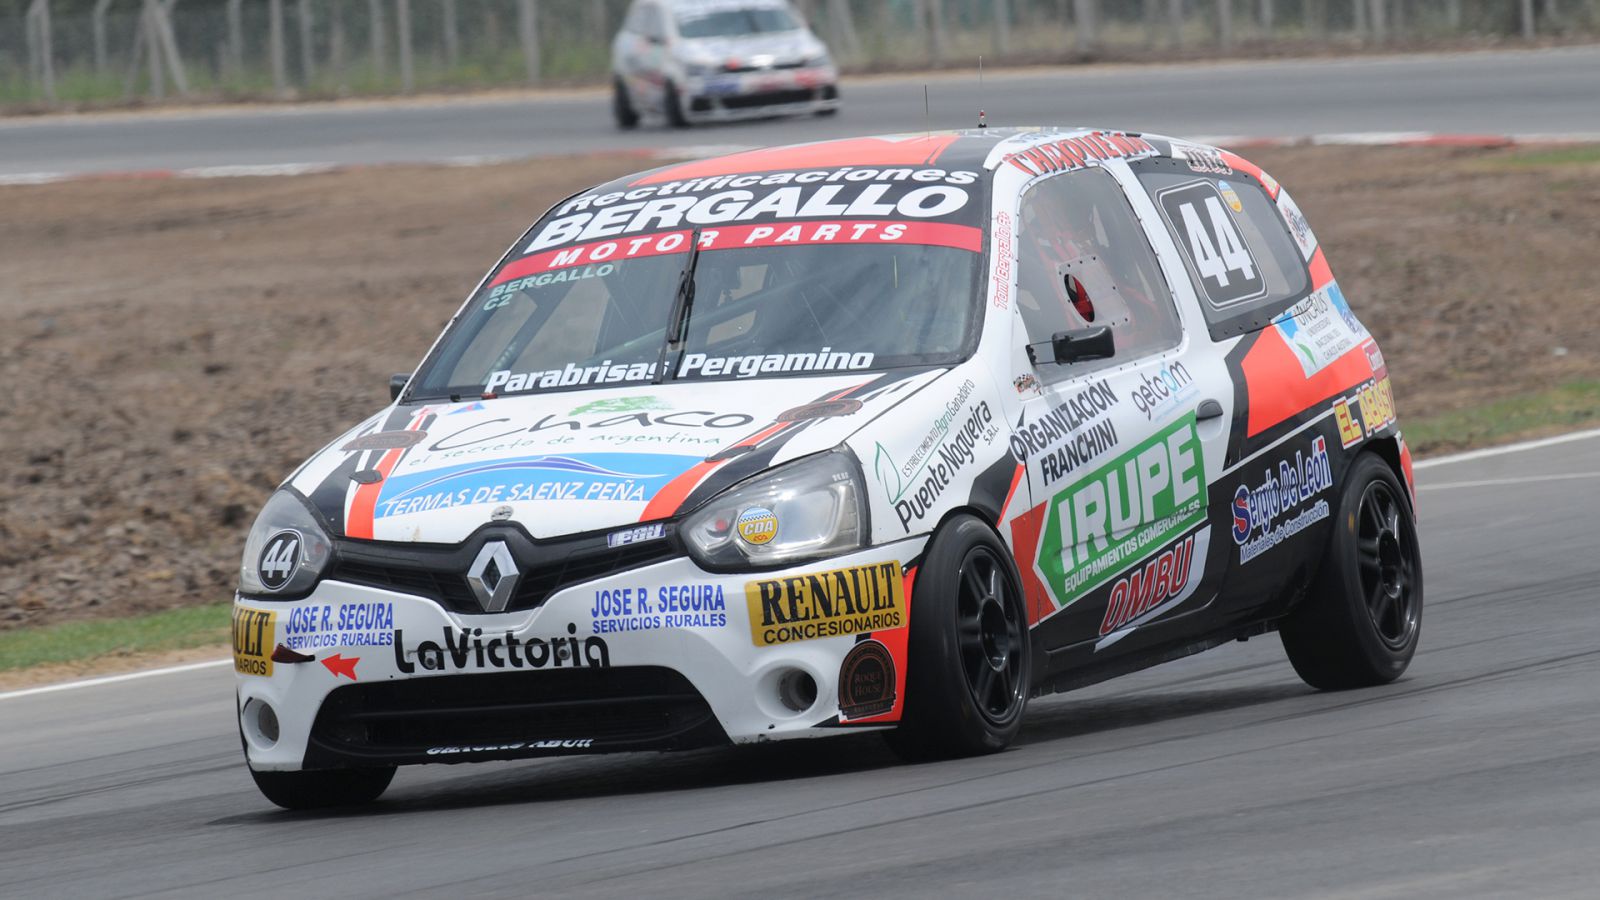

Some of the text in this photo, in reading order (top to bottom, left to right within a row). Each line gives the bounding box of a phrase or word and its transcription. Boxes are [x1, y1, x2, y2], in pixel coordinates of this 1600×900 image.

[556, 166, 980, 217] Rectificaciones
[524, 184, 969, 254] BERGALLO
[1178, 196, 1256, 288] 44
[549, 222, 907, 269] MOTOR PARTS
[488, 263, 614, 298] BERGALLO
[484, 347, 875, 394] Parabrisas Pergamino
[428, 411, 755, 452] Chaco
[444, 437, 535, 458] secreto
[546, 434, 576, 446] de
[594, 431, 721, 448] argentina
[1334, 396, 1364, 449] EL
[1040, 418, 1119, 487] FRANCHINI
[383, 478, 647, 519] TERMAS DE SAENZ PEÑA
[1058, 424, 1200, 574] IRUPE
[1232, 468, 1280, 545] Sergio
[1279, 460, 1298, 512] De
[744, 521, 774, 536] CDA
[261, 539, 299, 579] 44
[1064, 534, 1138, 594] EQUIPAMIENTOS
[591, 584, 726, 618] JOSE R. SEGURA
[757, 562, 896, 627] RENAULT
[1099, 535, 1195, 637] OMBU
[286, 603, 393, 634] JOSE R. SEGURA
[287, 632, 393, 650] SERVICIOS RURALES
[593, 613, 727, 634] SERVICIOS RURALES
[764, 611, 901, 644] CONCESIONARIOS
